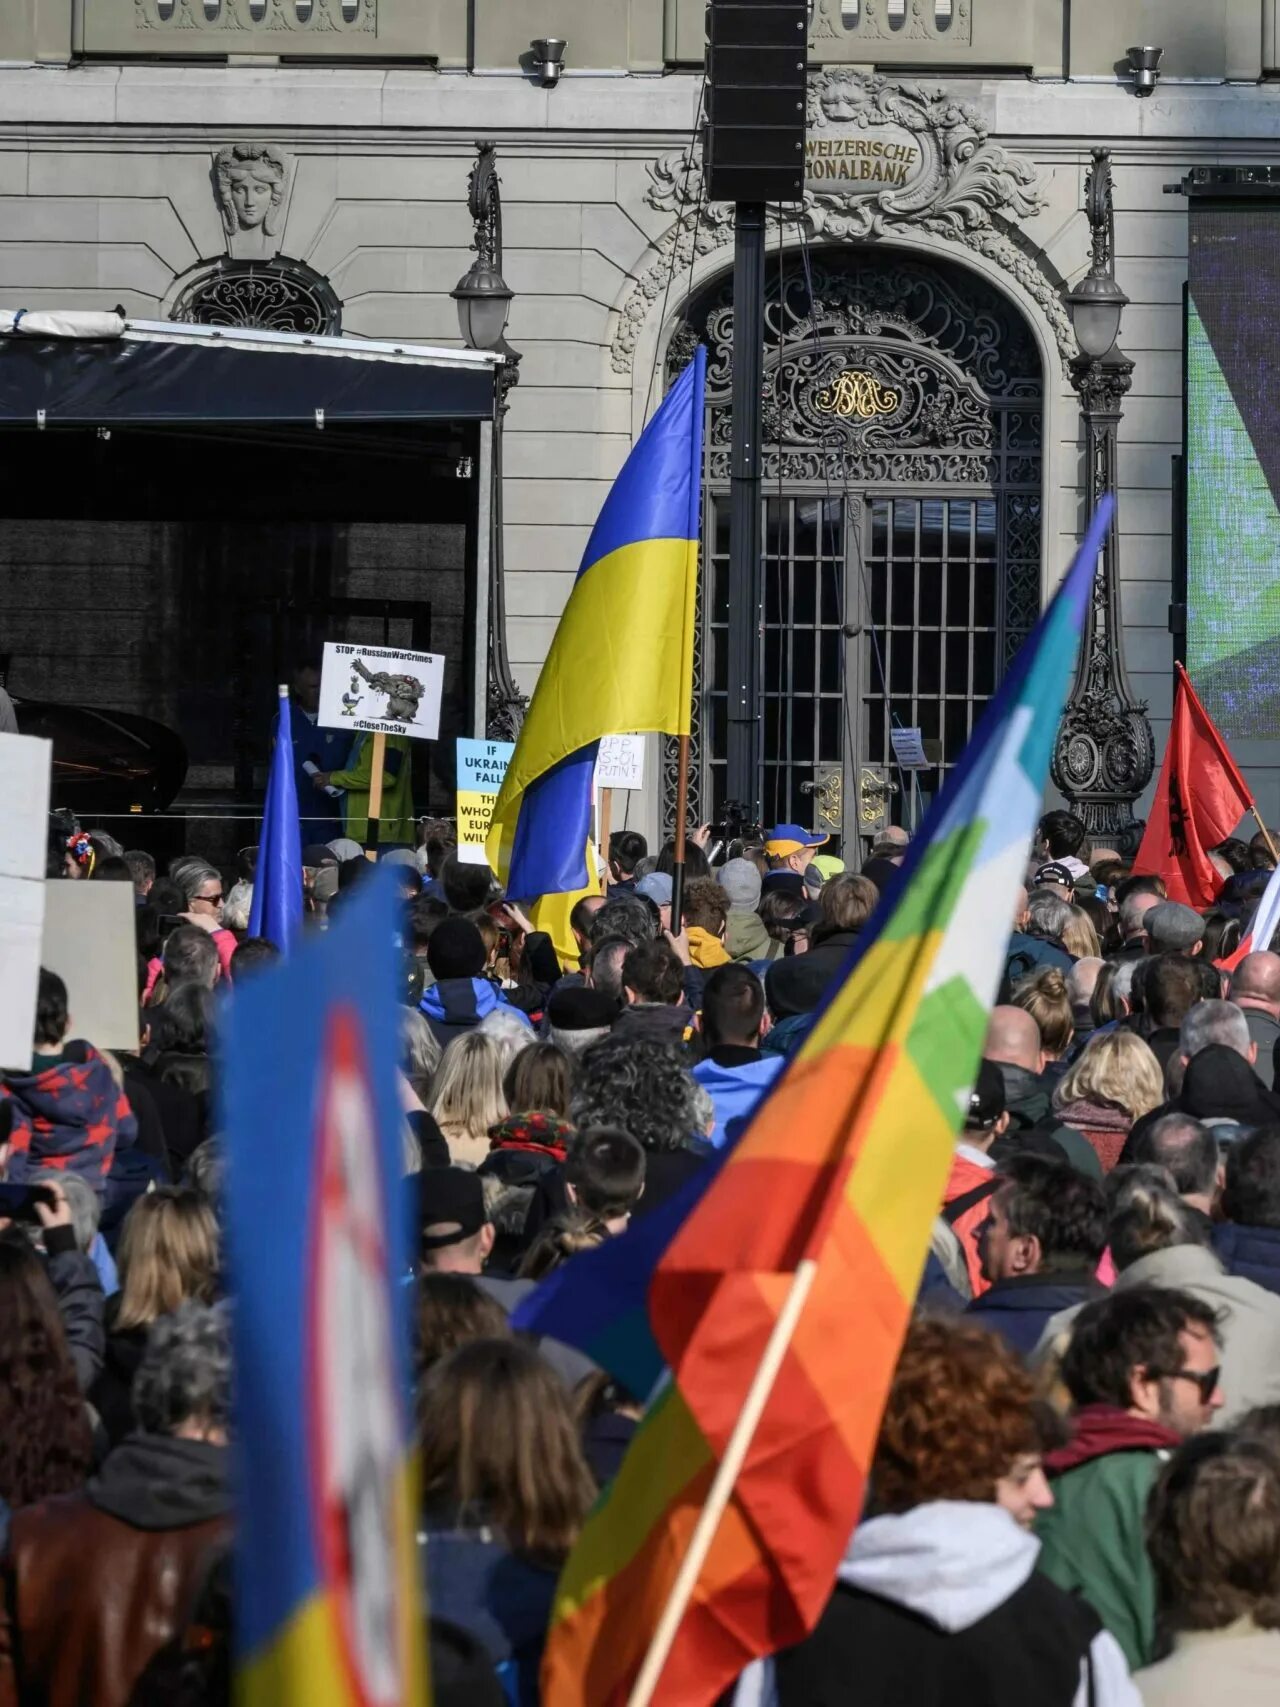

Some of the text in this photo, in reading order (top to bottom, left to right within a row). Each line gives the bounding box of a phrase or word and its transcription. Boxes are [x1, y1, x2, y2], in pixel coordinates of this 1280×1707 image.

[804, 140, 918, 163] WEIZERISCHE
[806, 160, 910, 185] IONALBANK
[335, 645, 433, 663] STOP #RussianWarCrimes
[353, 720, 407, 734] #CloseTheSky
[487, 746, 497, 756] IF
[465, 757, 510, 770] UKRAIN
[476, 772, 503, 784] FALL
[481, 795, 495, 805] TH
[460, 806, 492, 817] WHO
[469, 820, 490, 830] EUR
